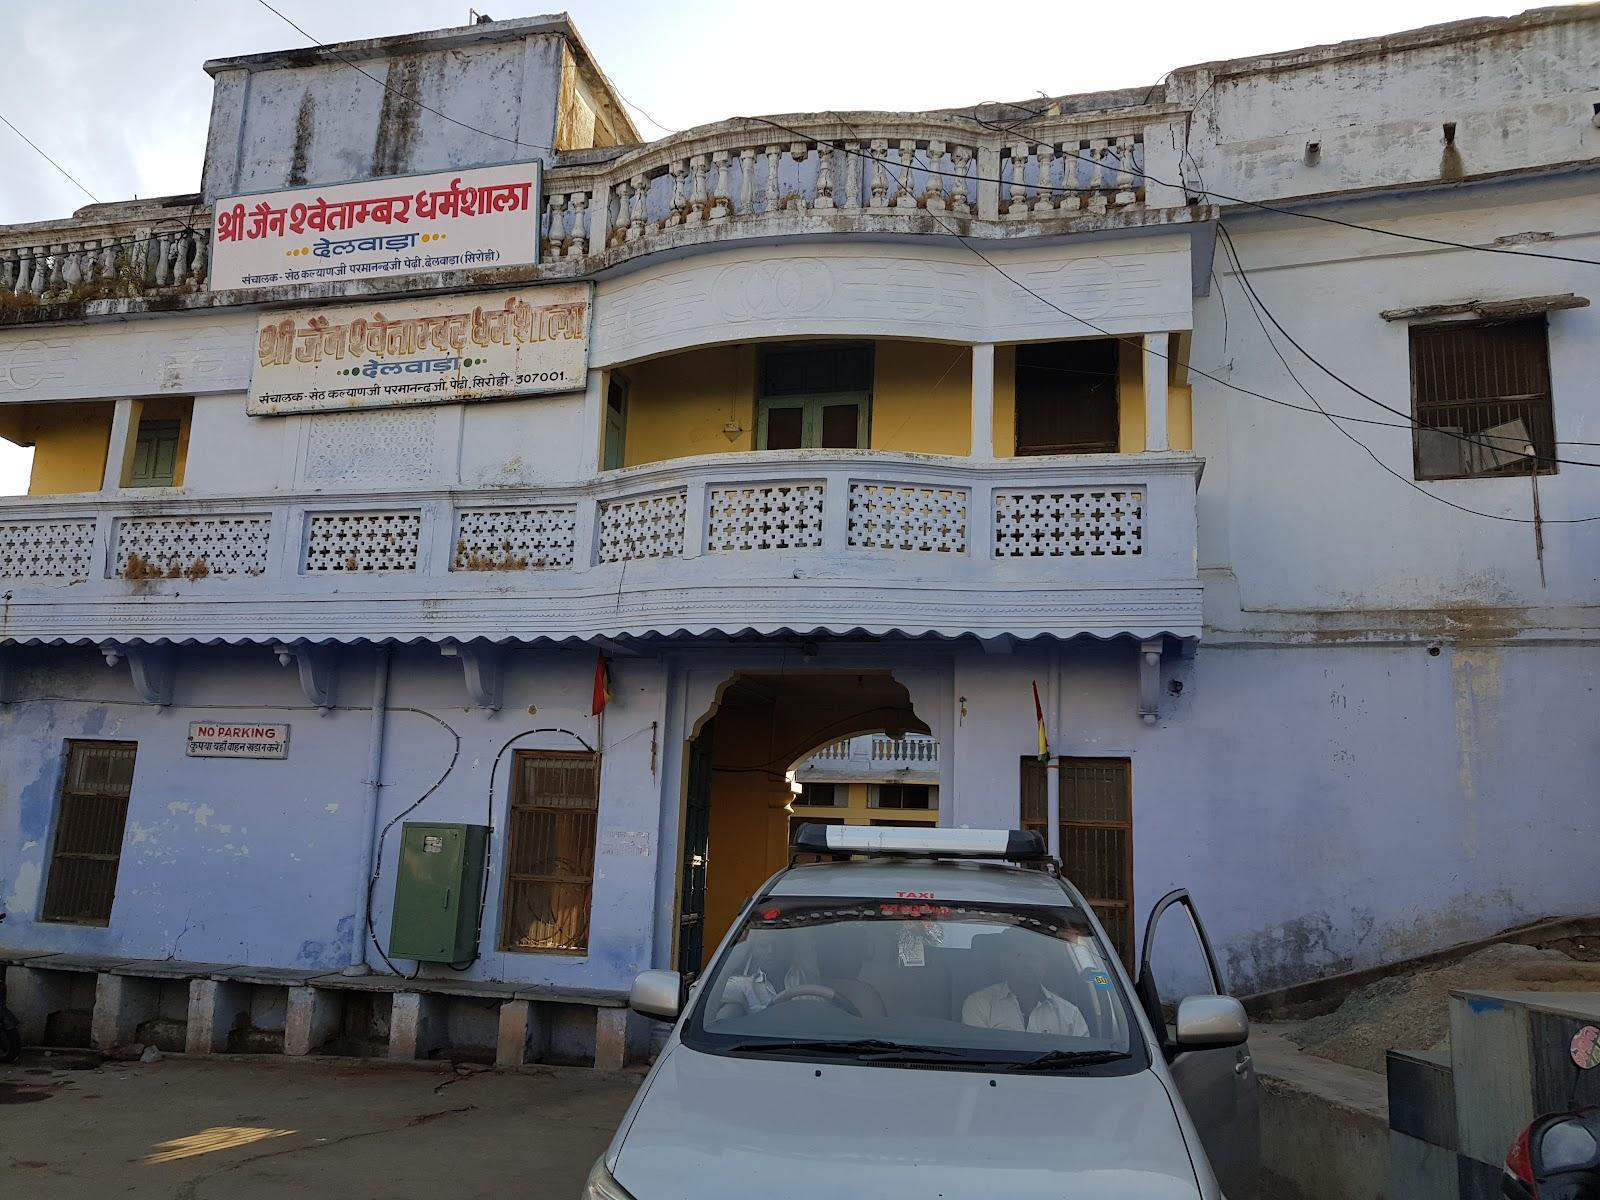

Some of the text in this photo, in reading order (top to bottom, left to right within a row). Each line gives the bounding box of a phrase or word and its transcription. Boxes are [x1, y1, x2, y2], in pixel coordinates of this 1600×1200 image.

[217, 177, 532, 242] श्री जैन श्वेताम्बर धर्मशाला
[313, 232, 420, 258] देलवाड़ा
[285, 268, 300, 281] सेठ
[301, 263, 348, 279] कल्याणजी
[349, 257, 401, 274] परमानन्दजी
[258, 319, 295, 367] श्री
[295, 315, 350, 362] जैन
[309, 388, 326, 400] सेठ
[327, 384, 381, 399] कल्याणजी
[198, 727, 276, 738] NO PARKING
[896, 891, 935, 899] TAXI
